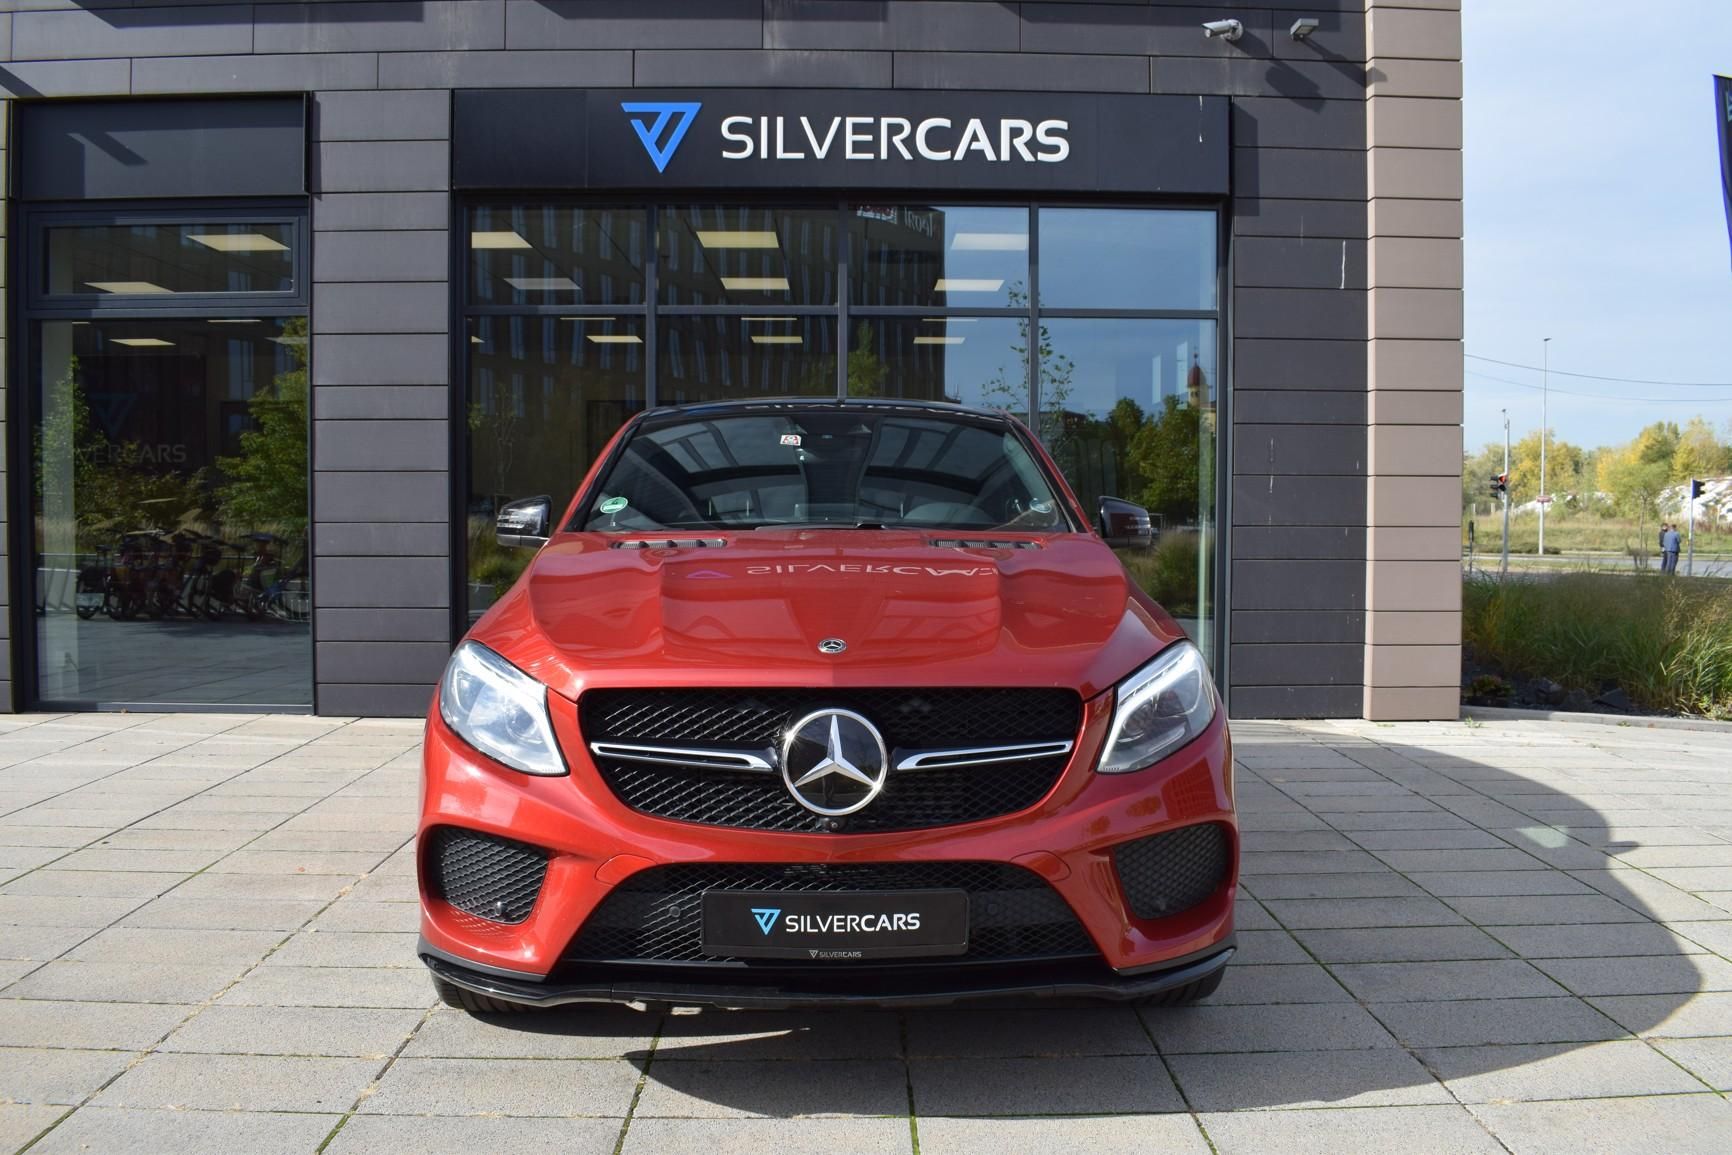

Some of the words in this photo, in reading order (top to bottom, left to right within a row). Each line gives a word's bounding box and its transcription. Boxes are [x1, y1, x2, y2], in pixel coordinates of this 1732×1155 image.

[721, 116, 1069, 162] SILVERCARS
[785, 913, 920, 933] SILVERCARS
[819, 951, 862, 959] SILVERCARS
